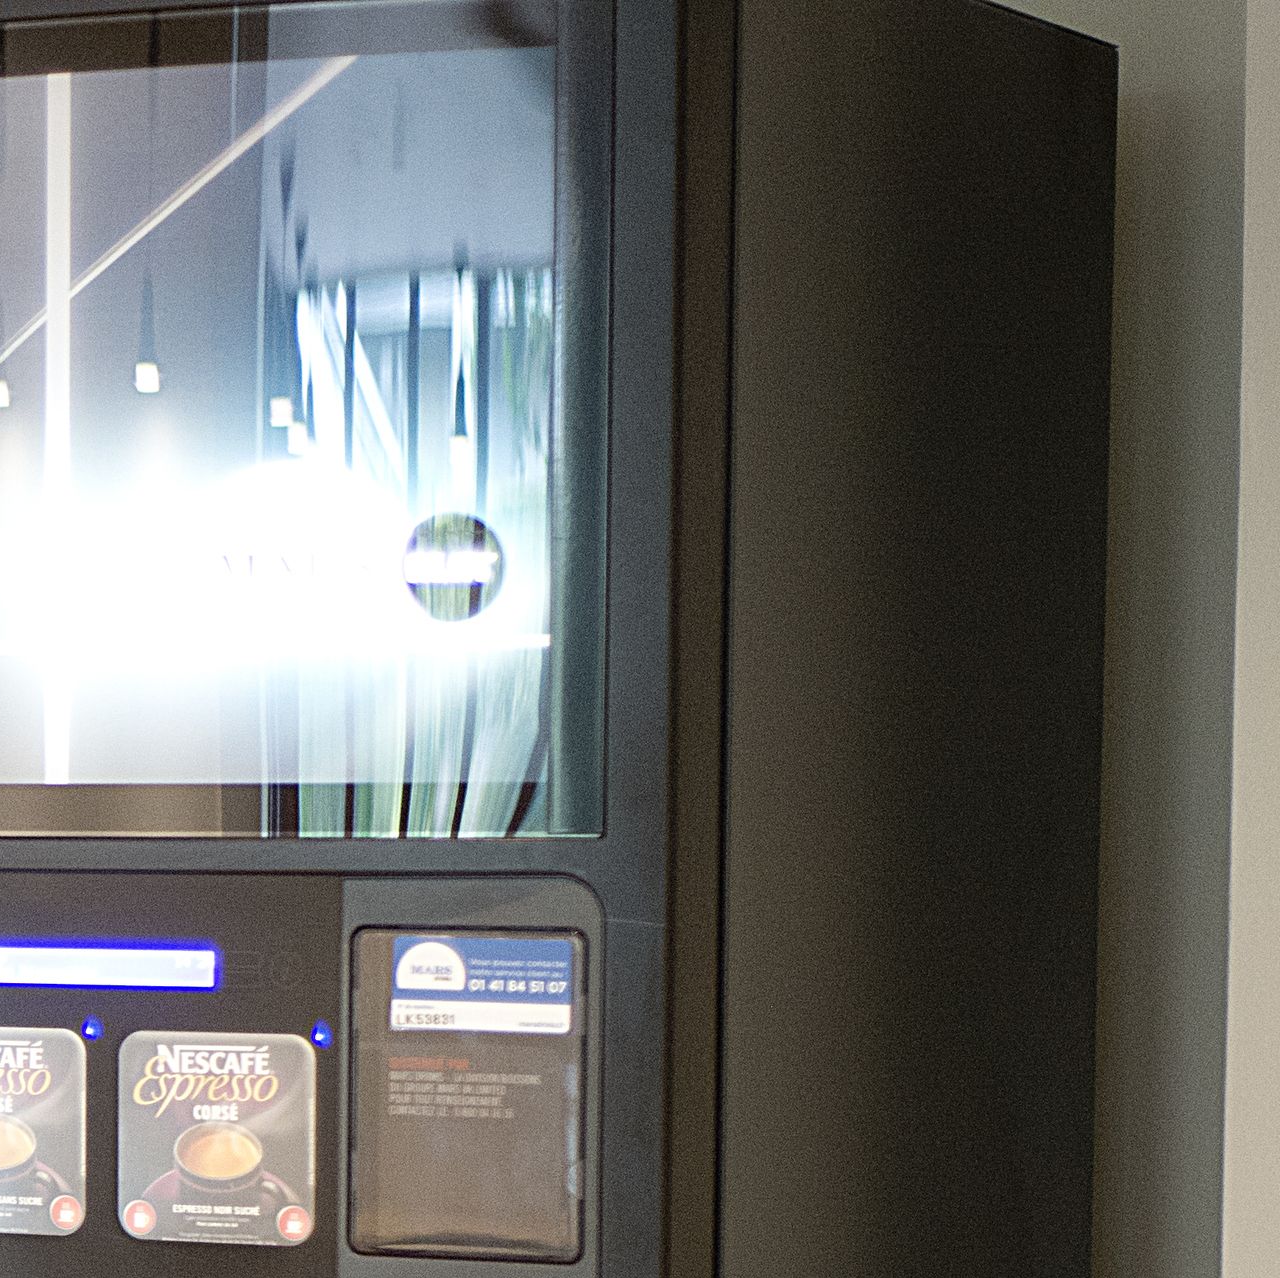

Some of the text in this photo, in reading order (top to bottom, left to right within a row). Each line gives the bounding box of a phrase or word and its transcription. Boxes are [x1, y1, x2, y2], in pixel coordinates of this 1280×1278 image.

[469, 979, 485, 991] 01
[547, 981, 567, 993] 07
[157, 1045, 270, 1074] NESCAFÉ
[133, 1056, 279, 1118] Espresso
[193, 1103, 238, 1121] CORSÉ
